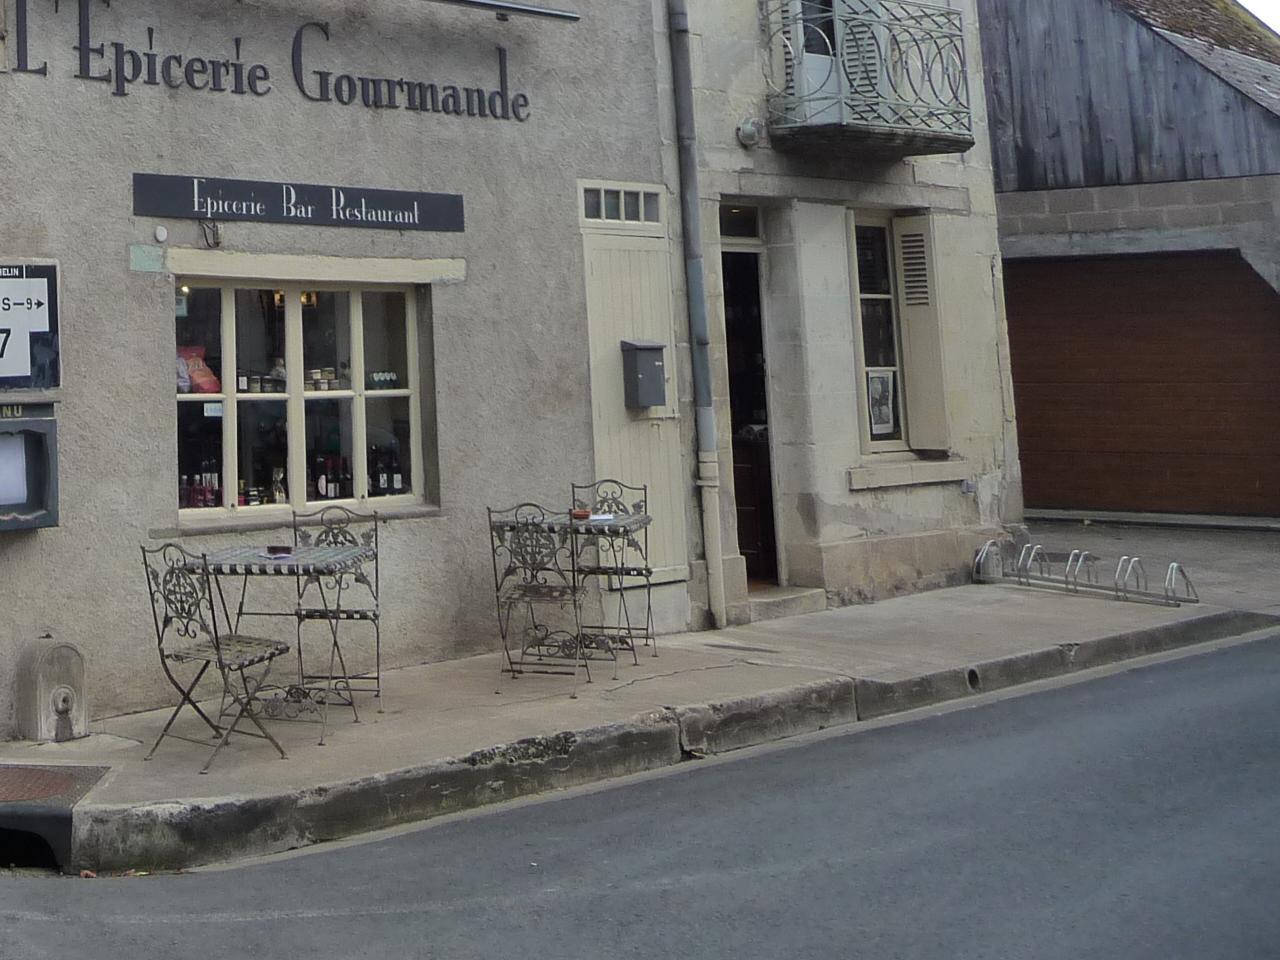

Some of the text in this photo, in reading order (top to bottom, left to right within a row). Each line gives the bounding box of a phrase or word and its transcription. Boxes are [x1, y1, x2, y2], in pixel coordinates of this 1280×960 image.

[292, 21, 531, 123] Gourmande
[192, 178, 419, 224] Epicerie Bar Restaurant
[26, 298, 33, 310] 9
